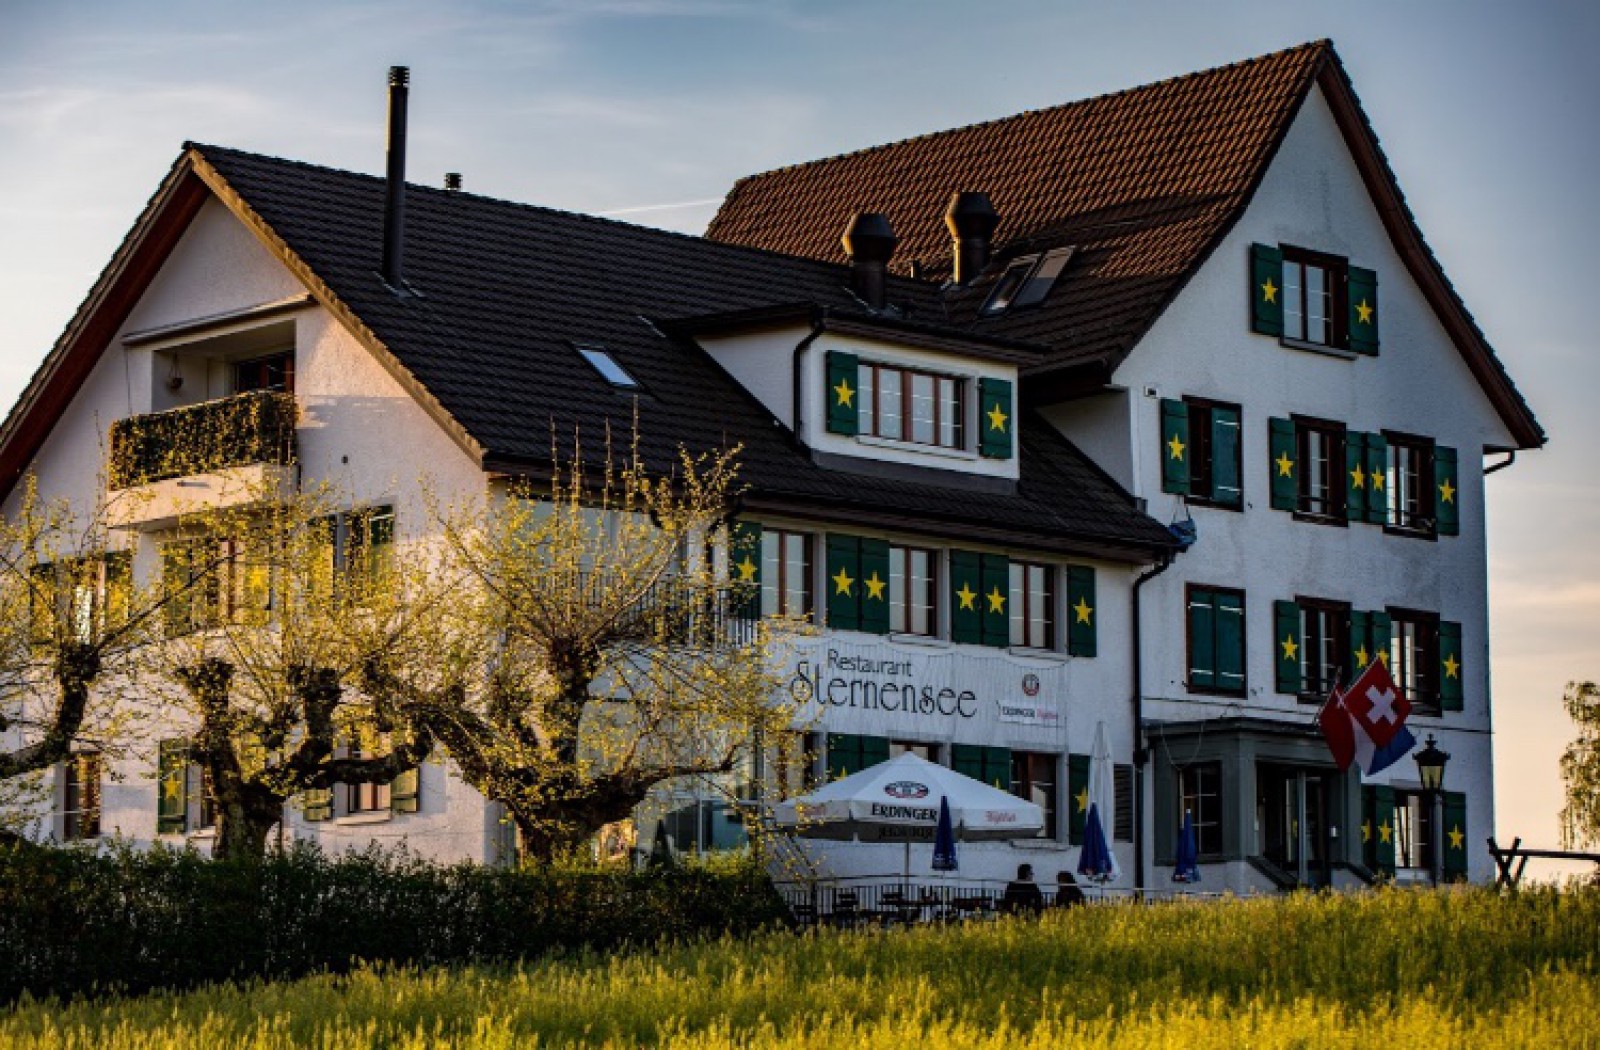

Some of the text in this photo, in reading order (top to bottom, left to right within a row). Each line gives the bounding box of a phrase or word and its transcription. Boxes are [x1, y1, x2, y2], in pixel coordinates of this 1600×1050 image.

[827, 648, 912, 677] Restaurant
[790, 660, 977, 718] Sternensee
[872, 802, 937, 822] ERDINGER
